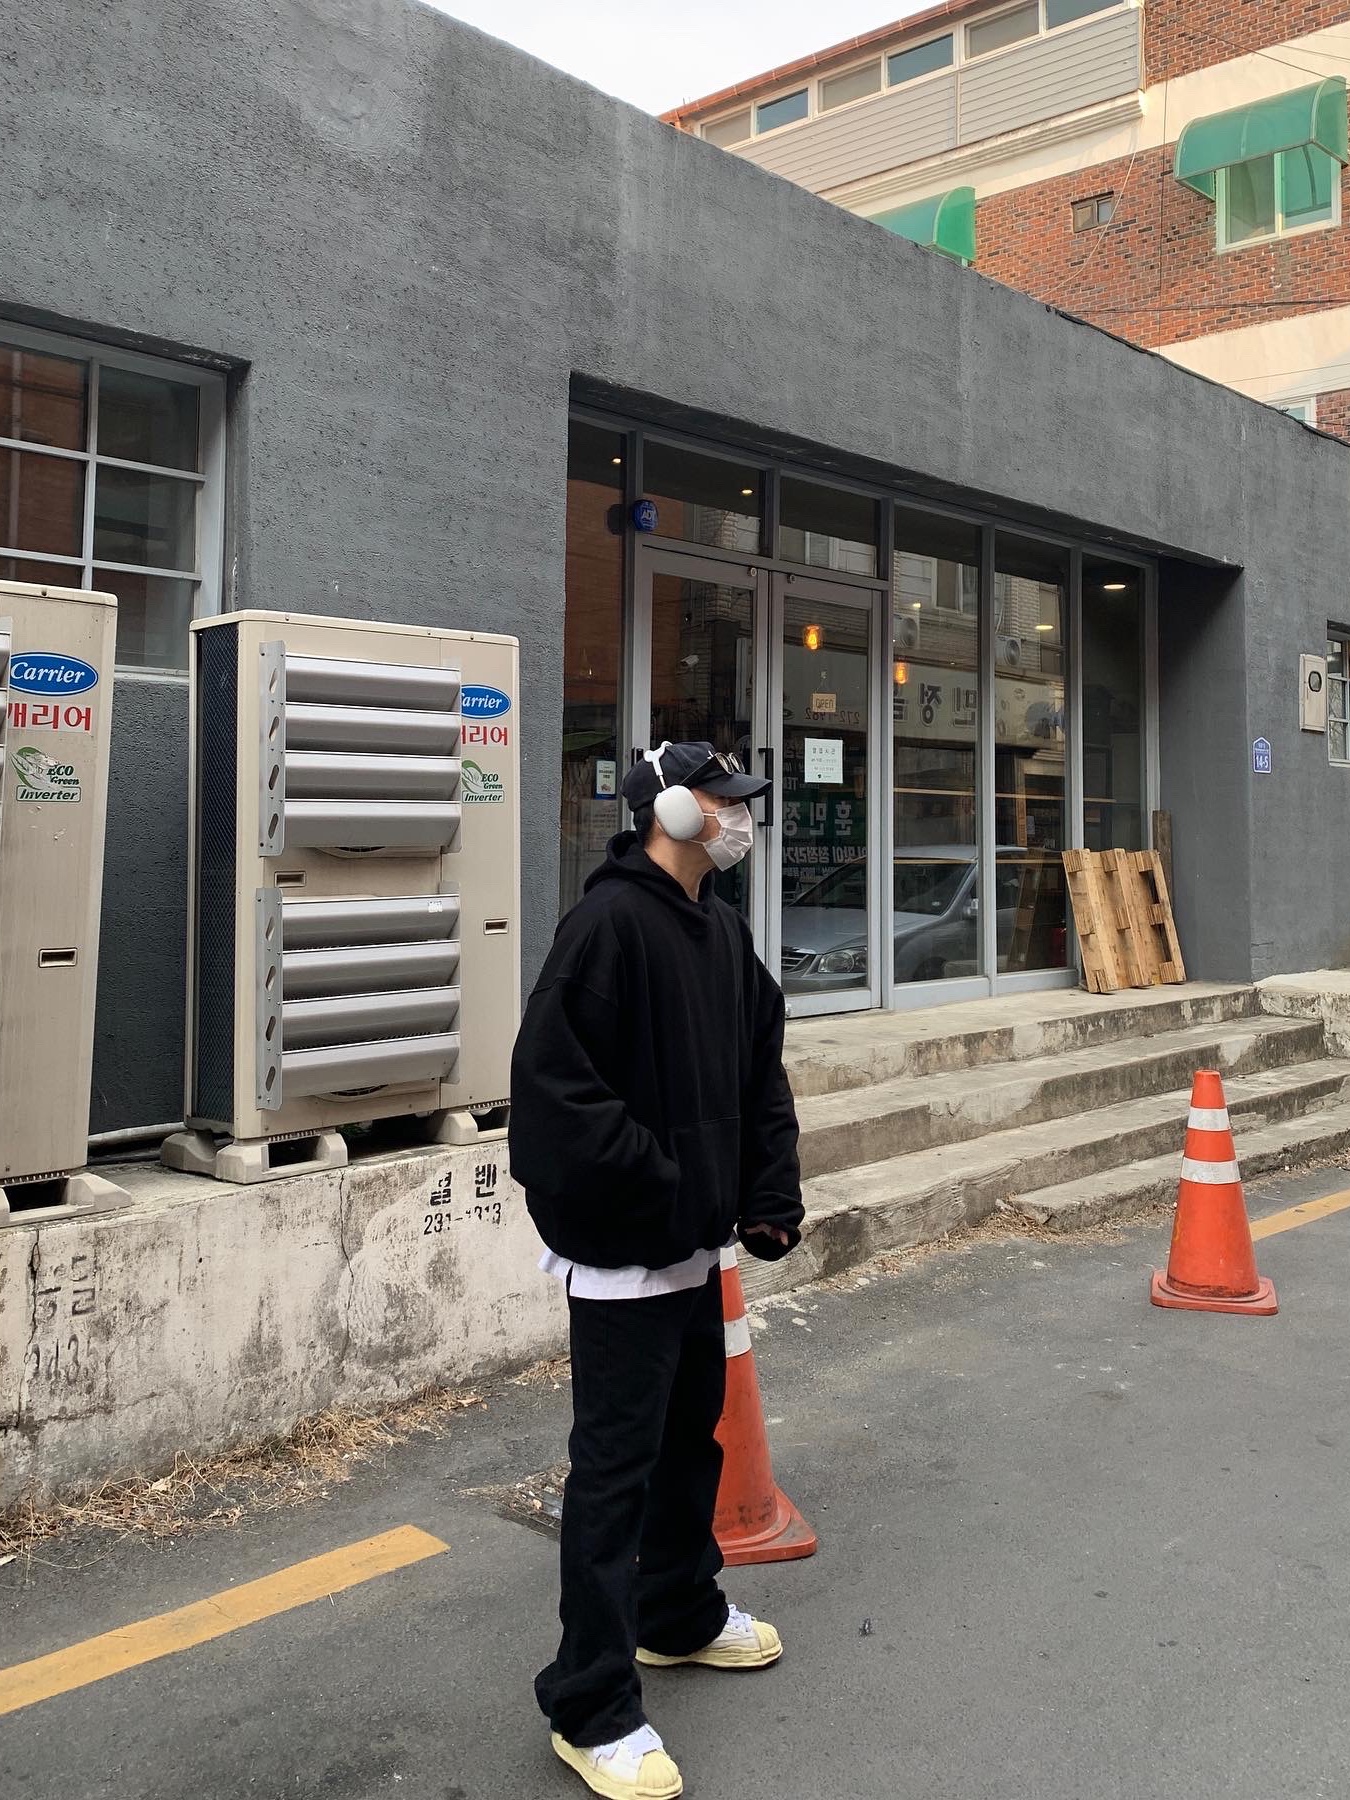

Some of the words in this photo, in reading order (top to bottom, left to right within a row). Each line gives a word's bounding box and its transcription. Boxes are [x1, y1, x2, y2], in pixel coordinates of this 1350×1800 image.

[11, 661, 86, 684] Carrier
[461, 691, 503, 709] arrier
[46, 764, 74, 777] ECO
[50, 776, 80, 786] Green
[481, 773, 499, 783] ECO
[483, 782, 503, 790] Green
[19, 788, 79, 801] Inverter
[464, 792, 503, 802] Inverter
